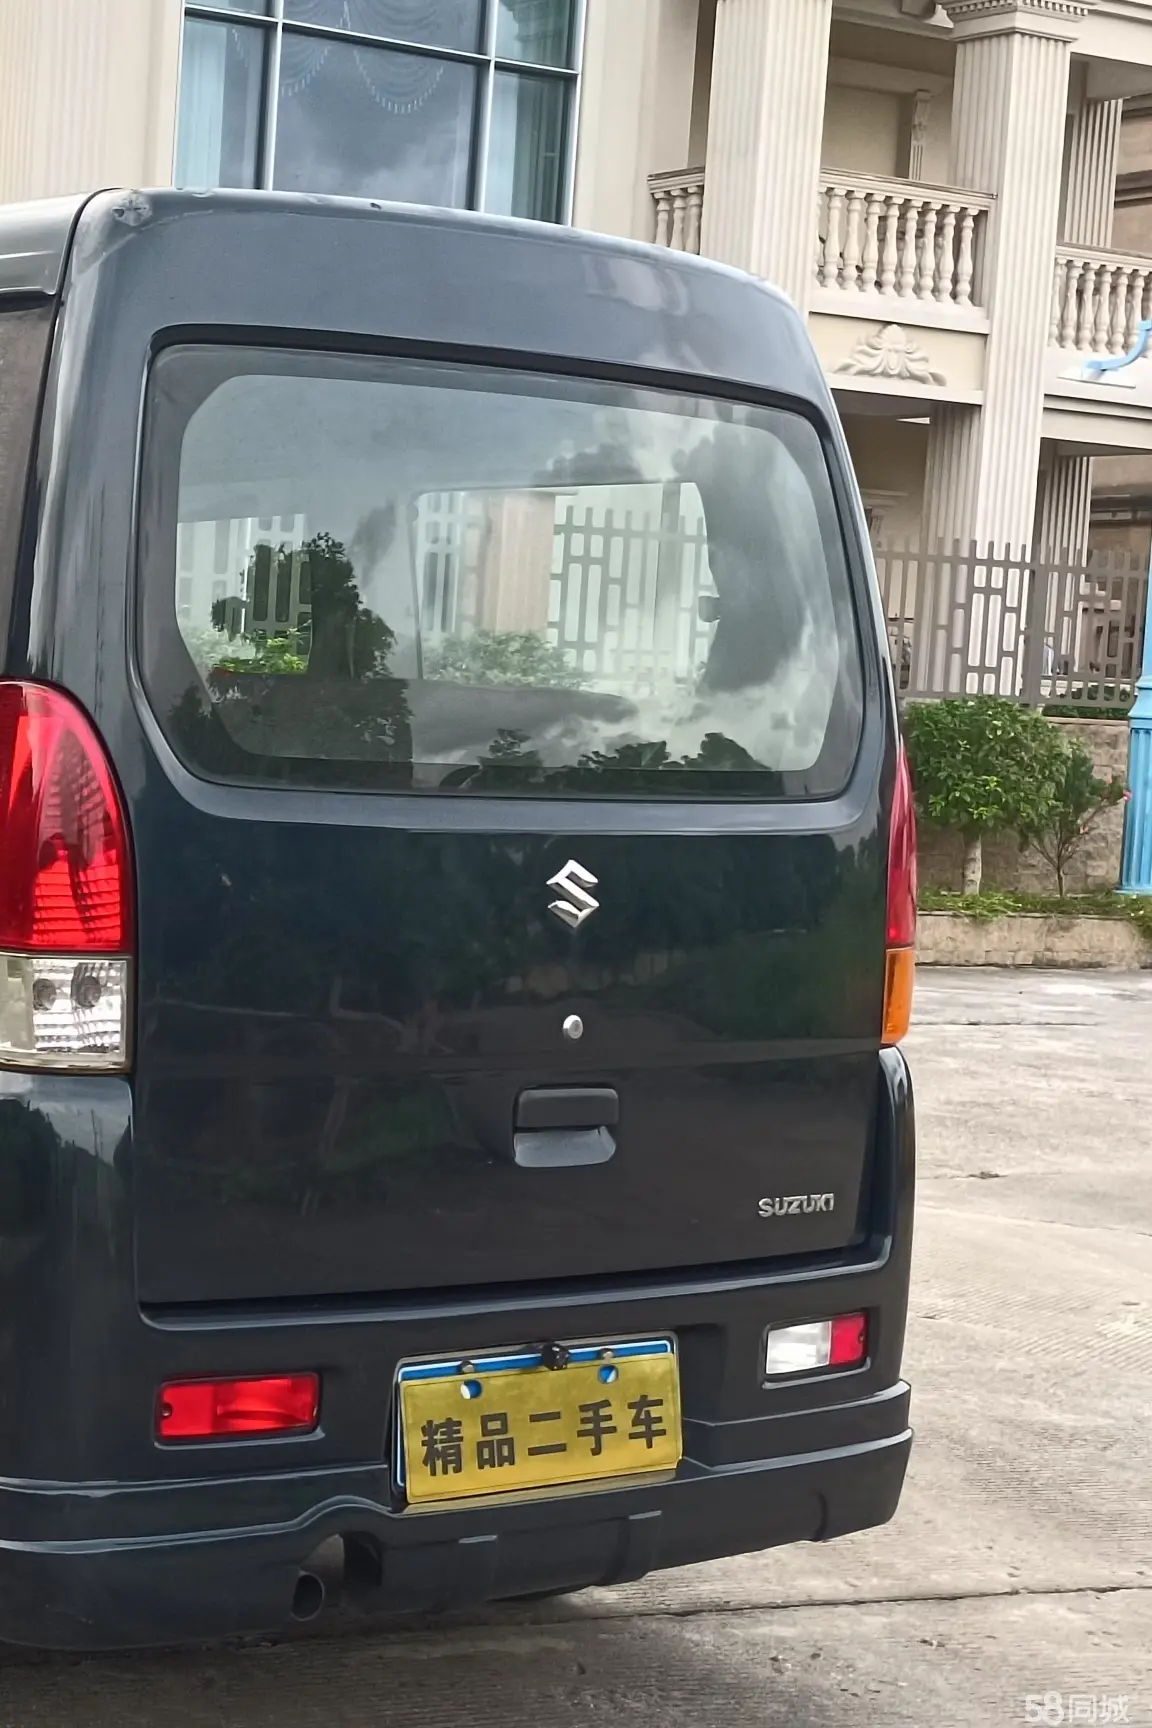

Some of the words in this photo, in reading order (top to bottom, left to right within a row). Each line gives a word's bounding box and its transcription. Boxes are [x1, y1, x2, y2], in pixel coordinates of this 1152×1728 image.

[758, 1192, 835, 1218] SUZUKI
[420, 1394, 667, 1477] 精品二手车
